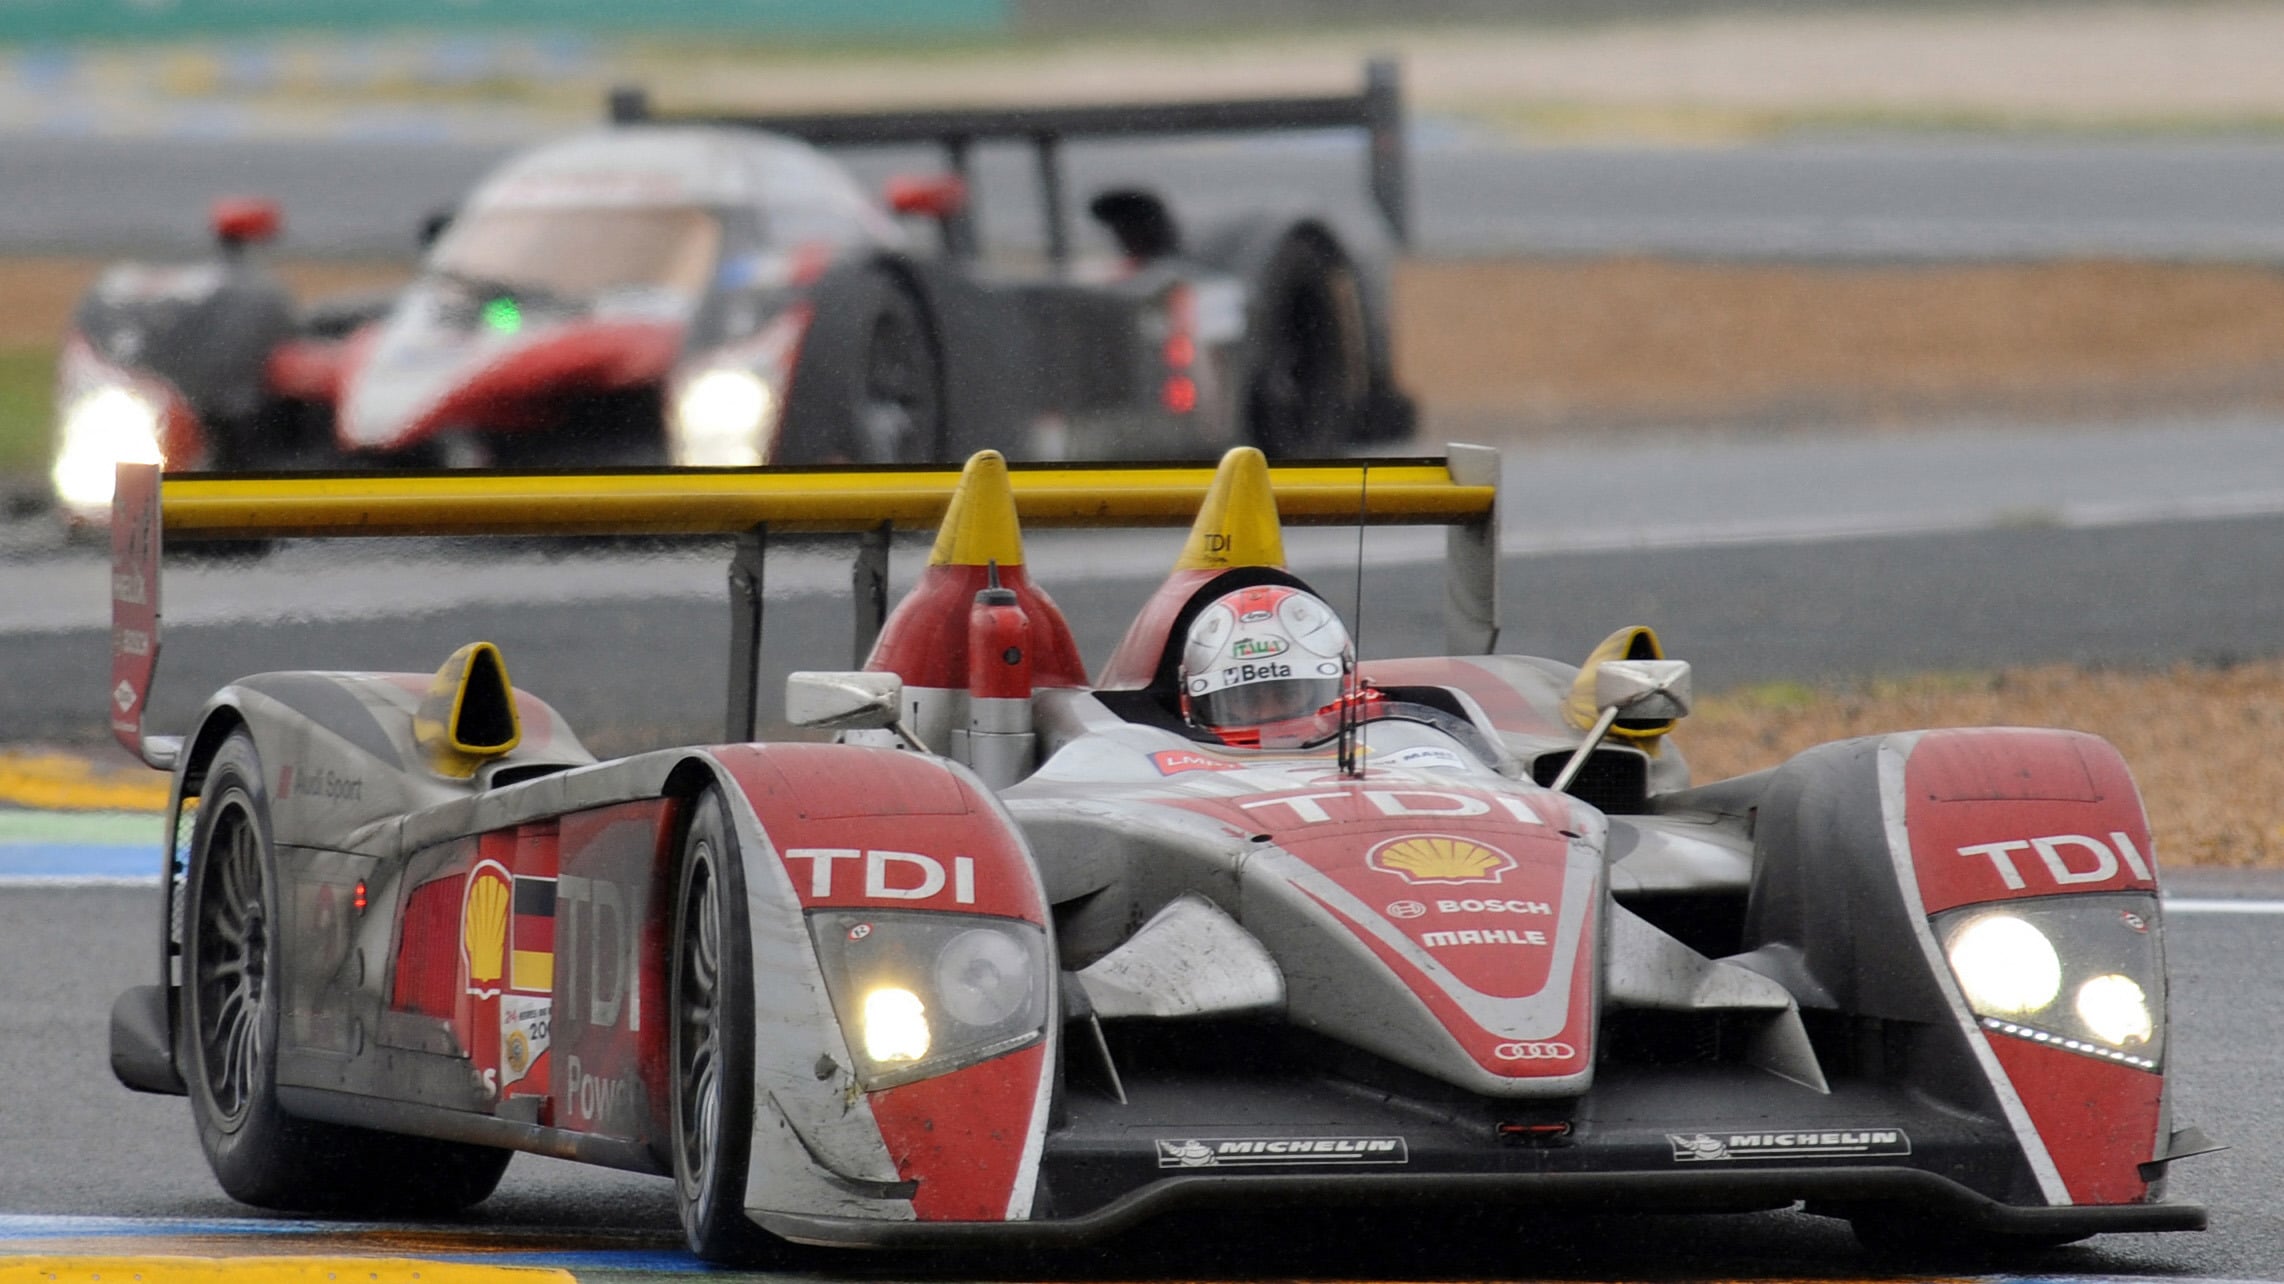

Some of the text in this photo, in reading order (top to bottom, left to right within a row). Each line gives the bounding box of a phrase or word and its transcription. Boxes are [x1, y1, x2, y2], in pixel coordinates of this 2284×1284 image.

[1204, 534, 1231, 551] TDI
[1241, 662, 1291, 681] Beta
[326, 769, 363, 805] Sport
[1241, 791, 1544, 825] TDI
[1957, 832, 2152, 890] TDI
[785, 849, 975, 904] TDI
[1437, 900, 1552, 915] BOSCH
[1422, 930, 1547, 947] MAHLE
[557, 873, 640, 1031] TDI
[1218, 1140, 1397, 1153] MICHELIN
[1730, 1132, 1897, 1147] MICHELIN
